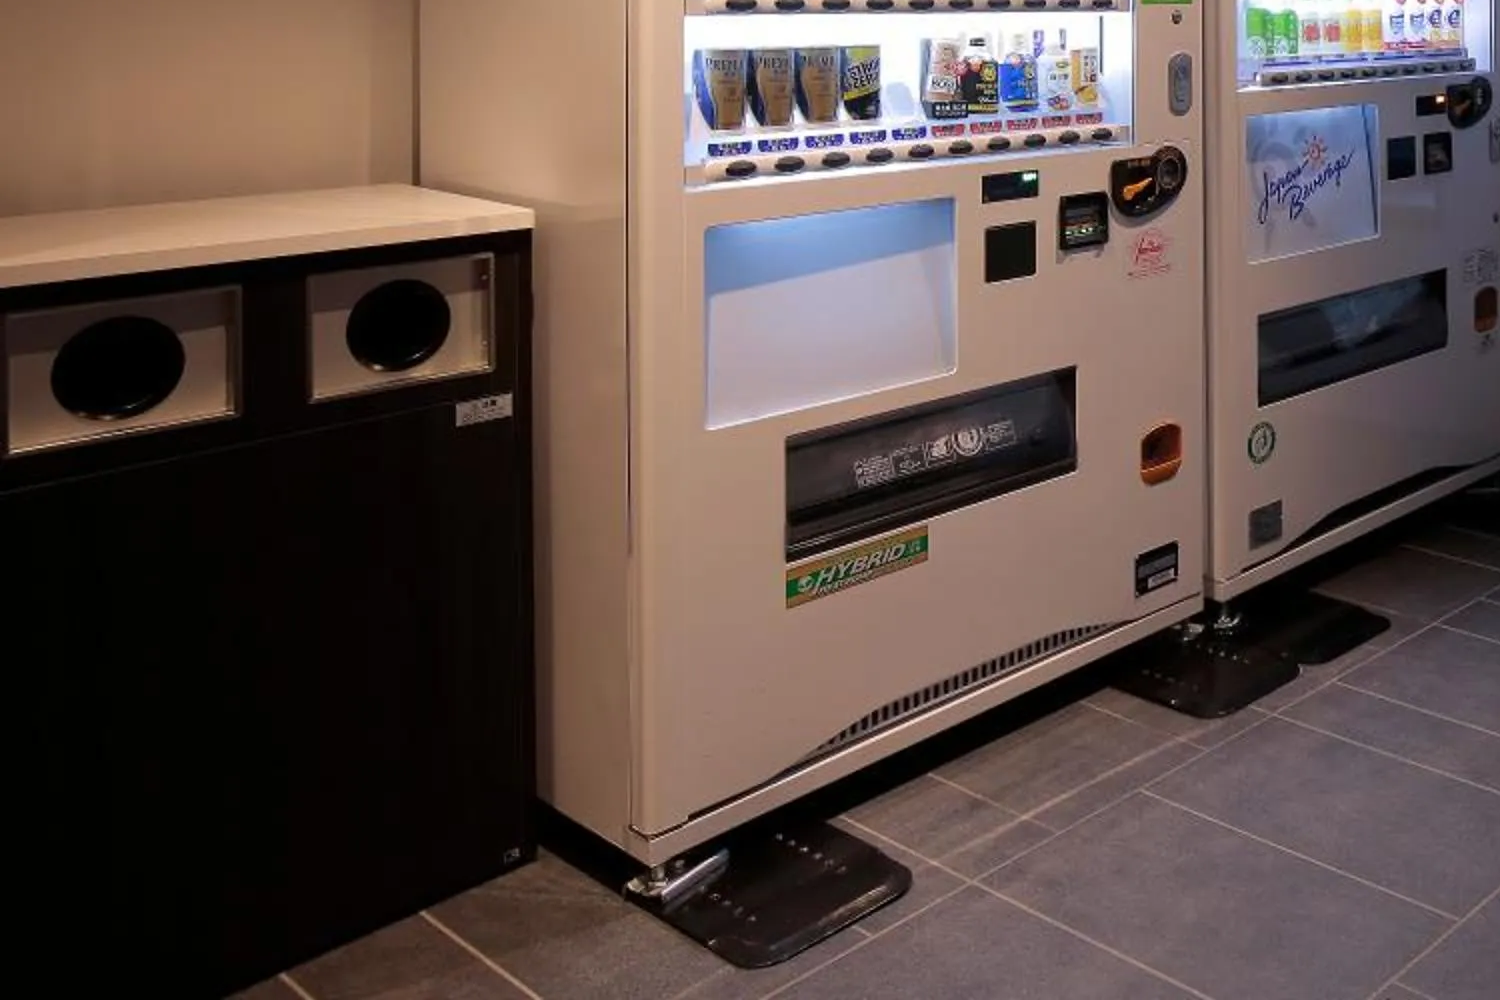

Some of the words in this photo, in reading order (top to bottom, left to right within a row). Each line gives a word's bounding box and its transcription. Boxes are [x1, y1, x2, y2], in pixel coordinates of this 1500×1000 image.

[1258, 159, 1310, 225] Japan
[1281, 148, 1356, 221] Beverage
[814, 544, 906, 591] HYBRID
